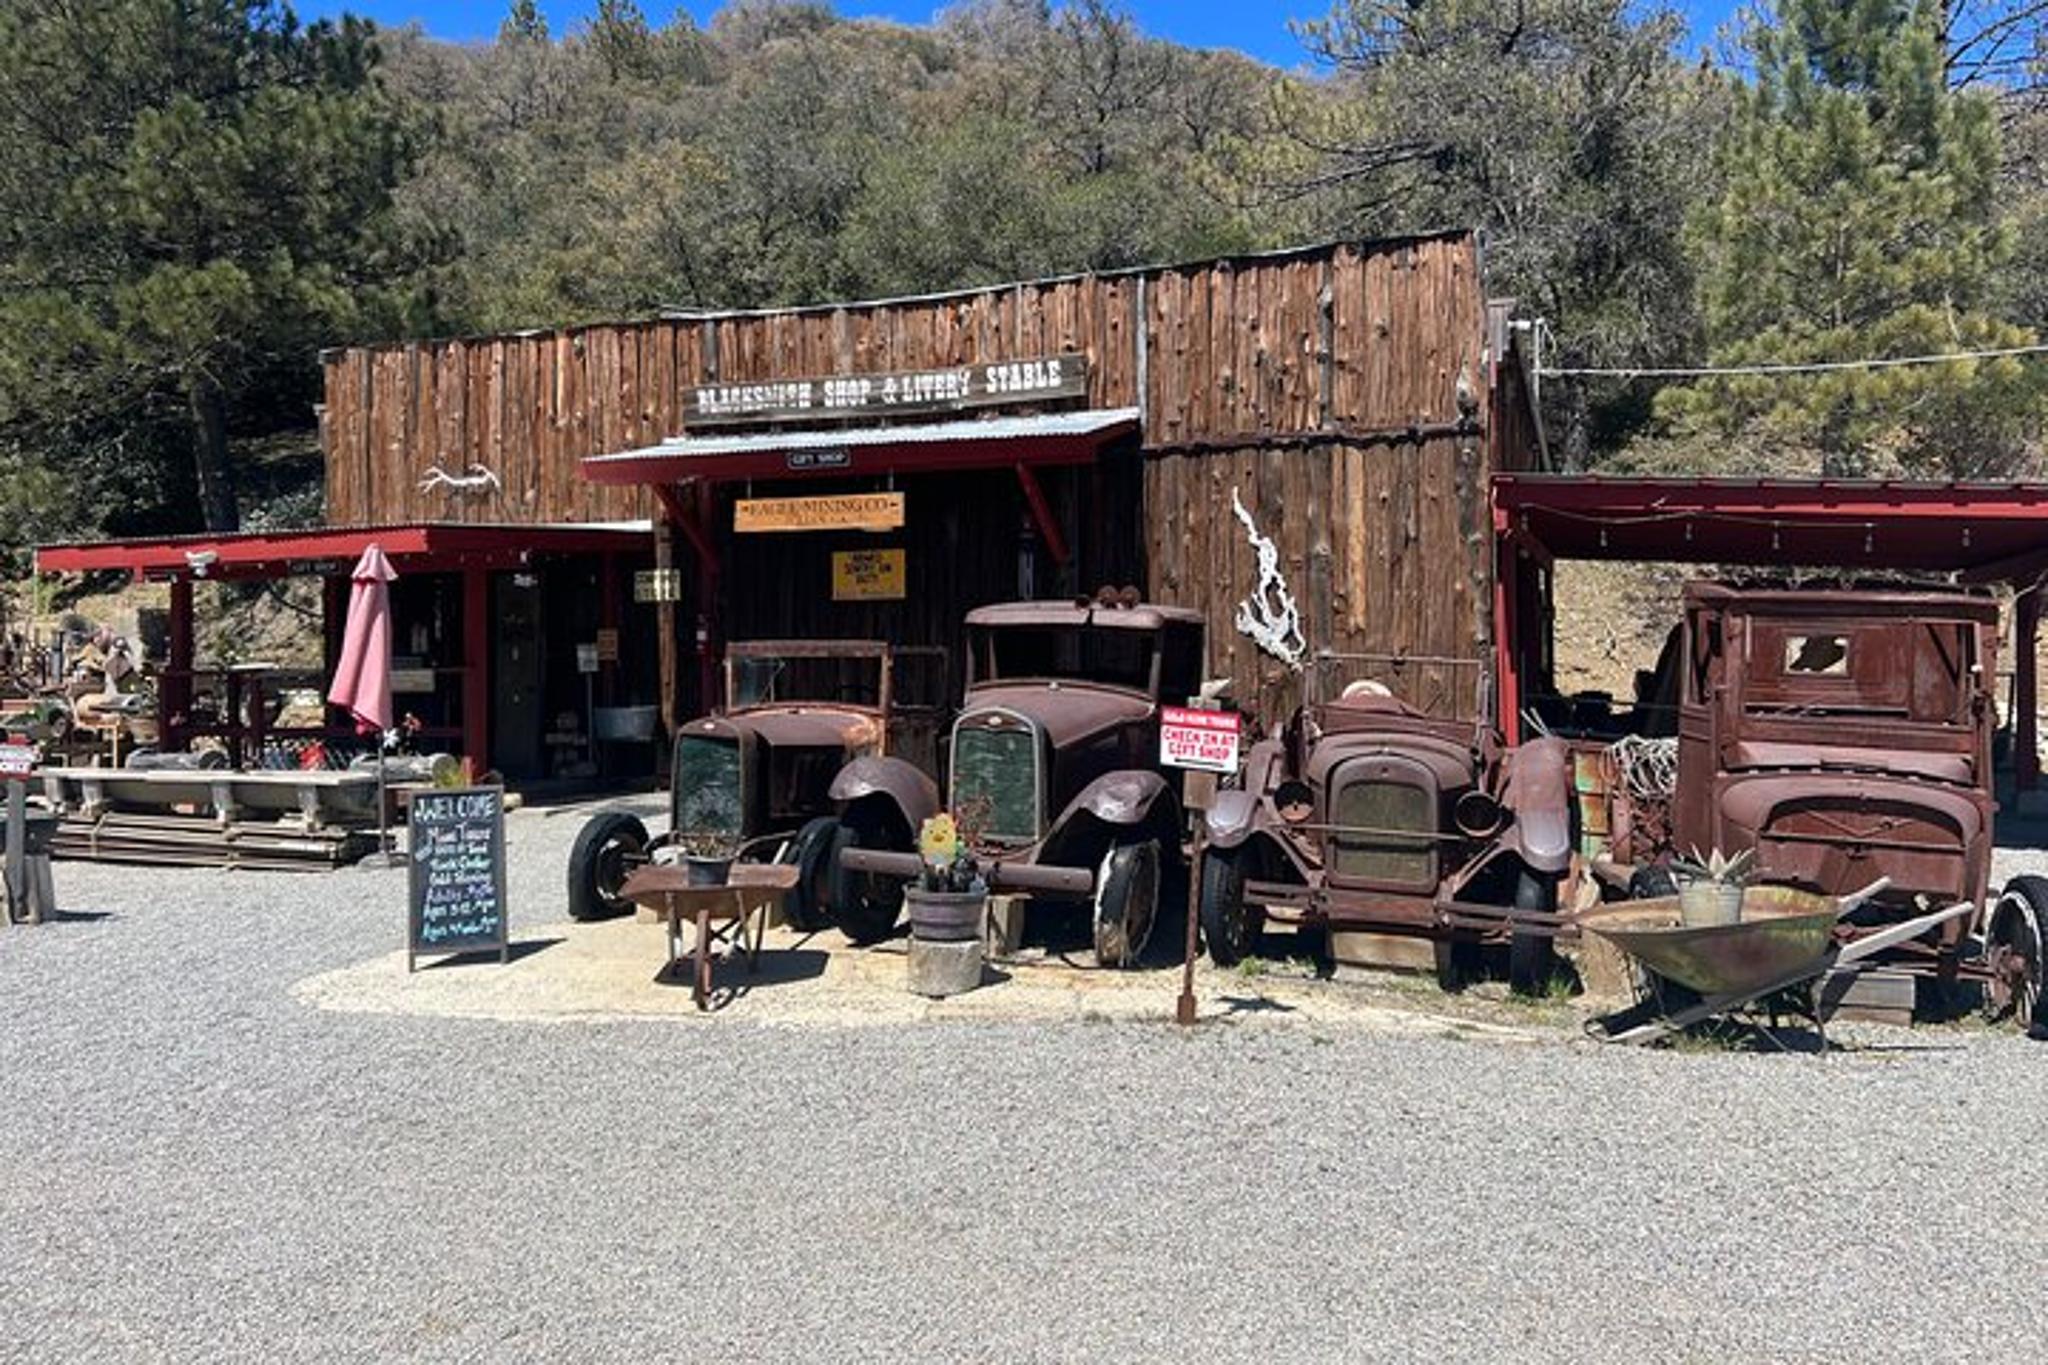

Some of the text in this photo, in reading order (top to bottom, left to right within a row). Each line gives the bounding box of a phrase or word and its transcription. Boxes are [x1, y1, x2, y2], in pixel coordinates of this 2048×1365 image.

[823, 379, 872, 407] SHOP
[881, 376, 897, 404] &
[901, 370, 971, 402] LIVERY
[985, 360, 1062, 393] STABLE
[1164, 727, 1201, 743] CHECK
[1203, 732, 1218, 745] IN
[1168, 741, 1230, 760] GIFT SHOP
